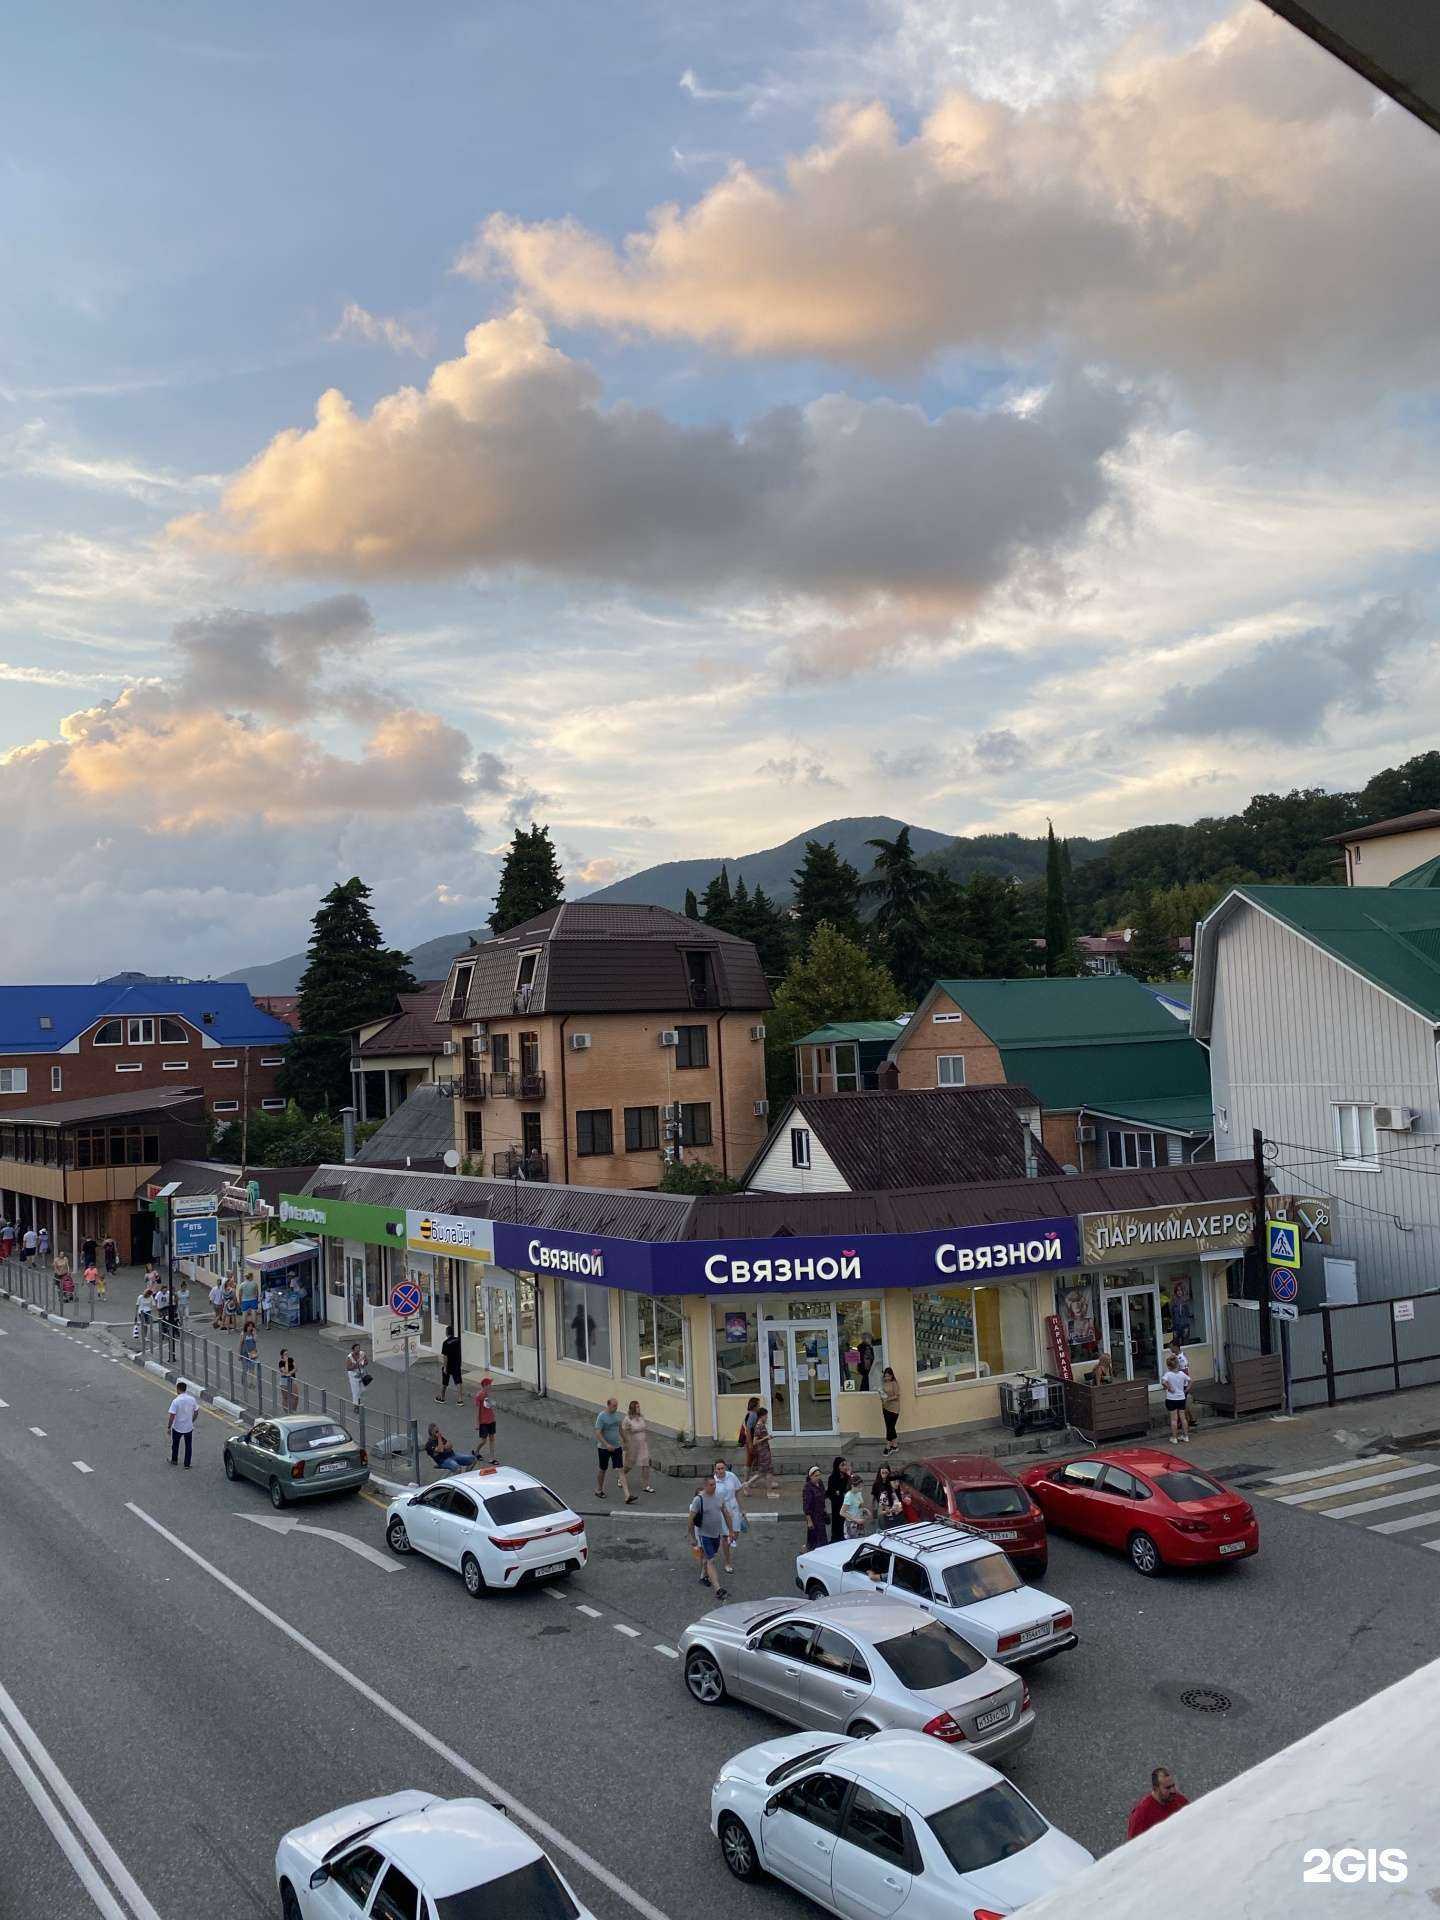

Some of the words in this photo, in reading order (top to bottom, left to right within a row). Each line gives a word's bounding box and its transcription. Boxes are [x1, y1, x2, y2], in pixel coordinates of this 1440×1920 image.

[432, 1221, 471, 1246] билайн
[1096, 1209, 1287, 1249] ПАРИКМАХЕРСКЯ
[528, 1239, 604, 1277] Связной
[704, 1249, 861, 1284] Связной
[935, 1232, 1062, 1274] Связной
